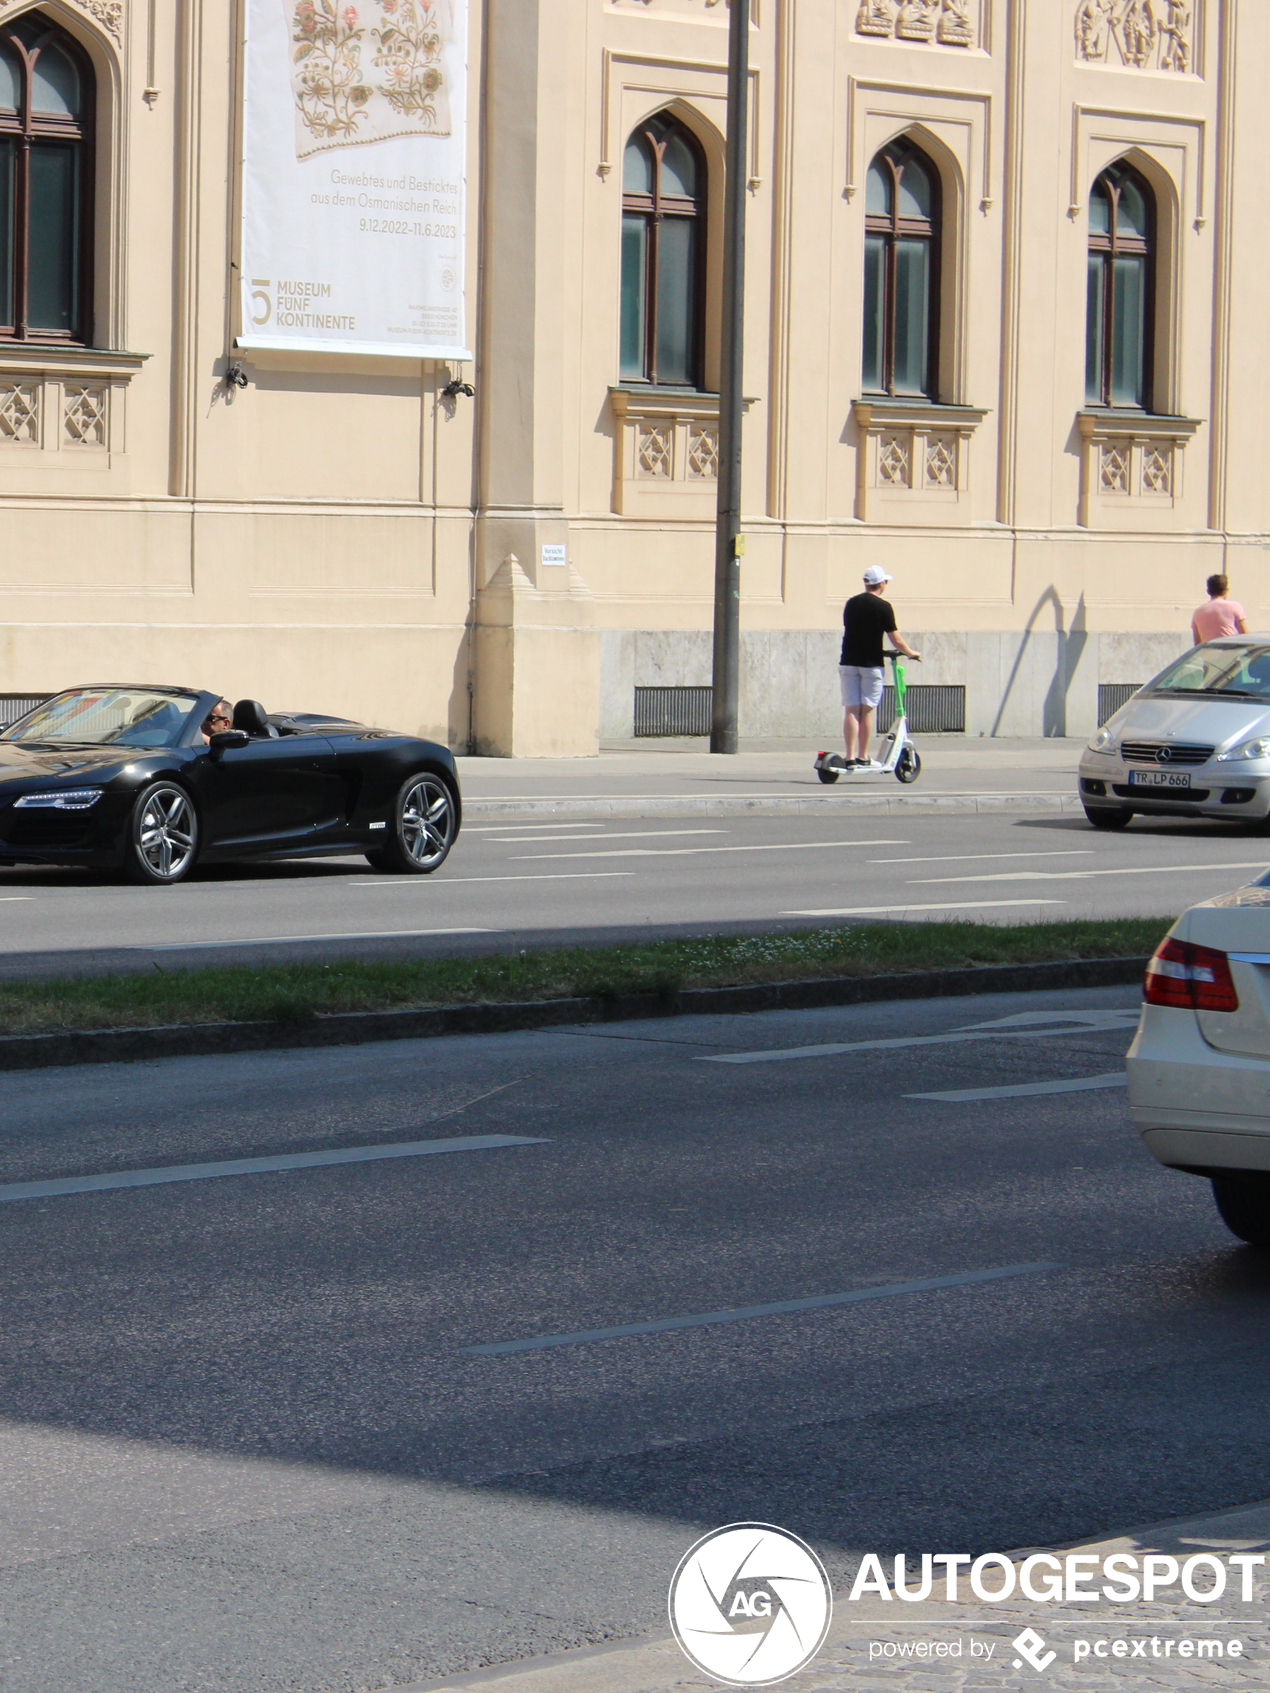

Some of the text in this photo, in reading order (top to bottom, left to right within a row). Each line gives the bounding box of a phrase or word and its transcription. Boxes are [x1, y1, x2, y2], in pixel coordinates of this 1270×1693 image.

[330, 169, 458, 194] Gewebtes und Besticktes
[311, 191, 456, 215] aus dem Osmanischen Reich
[277, 280, 331, 297] MUSEUM
[276, 296, 311, 312] FÜNF
[276, 311, 356, 330] KONTINENTE
[1135, 772, 1188, 787] TR LP 666
